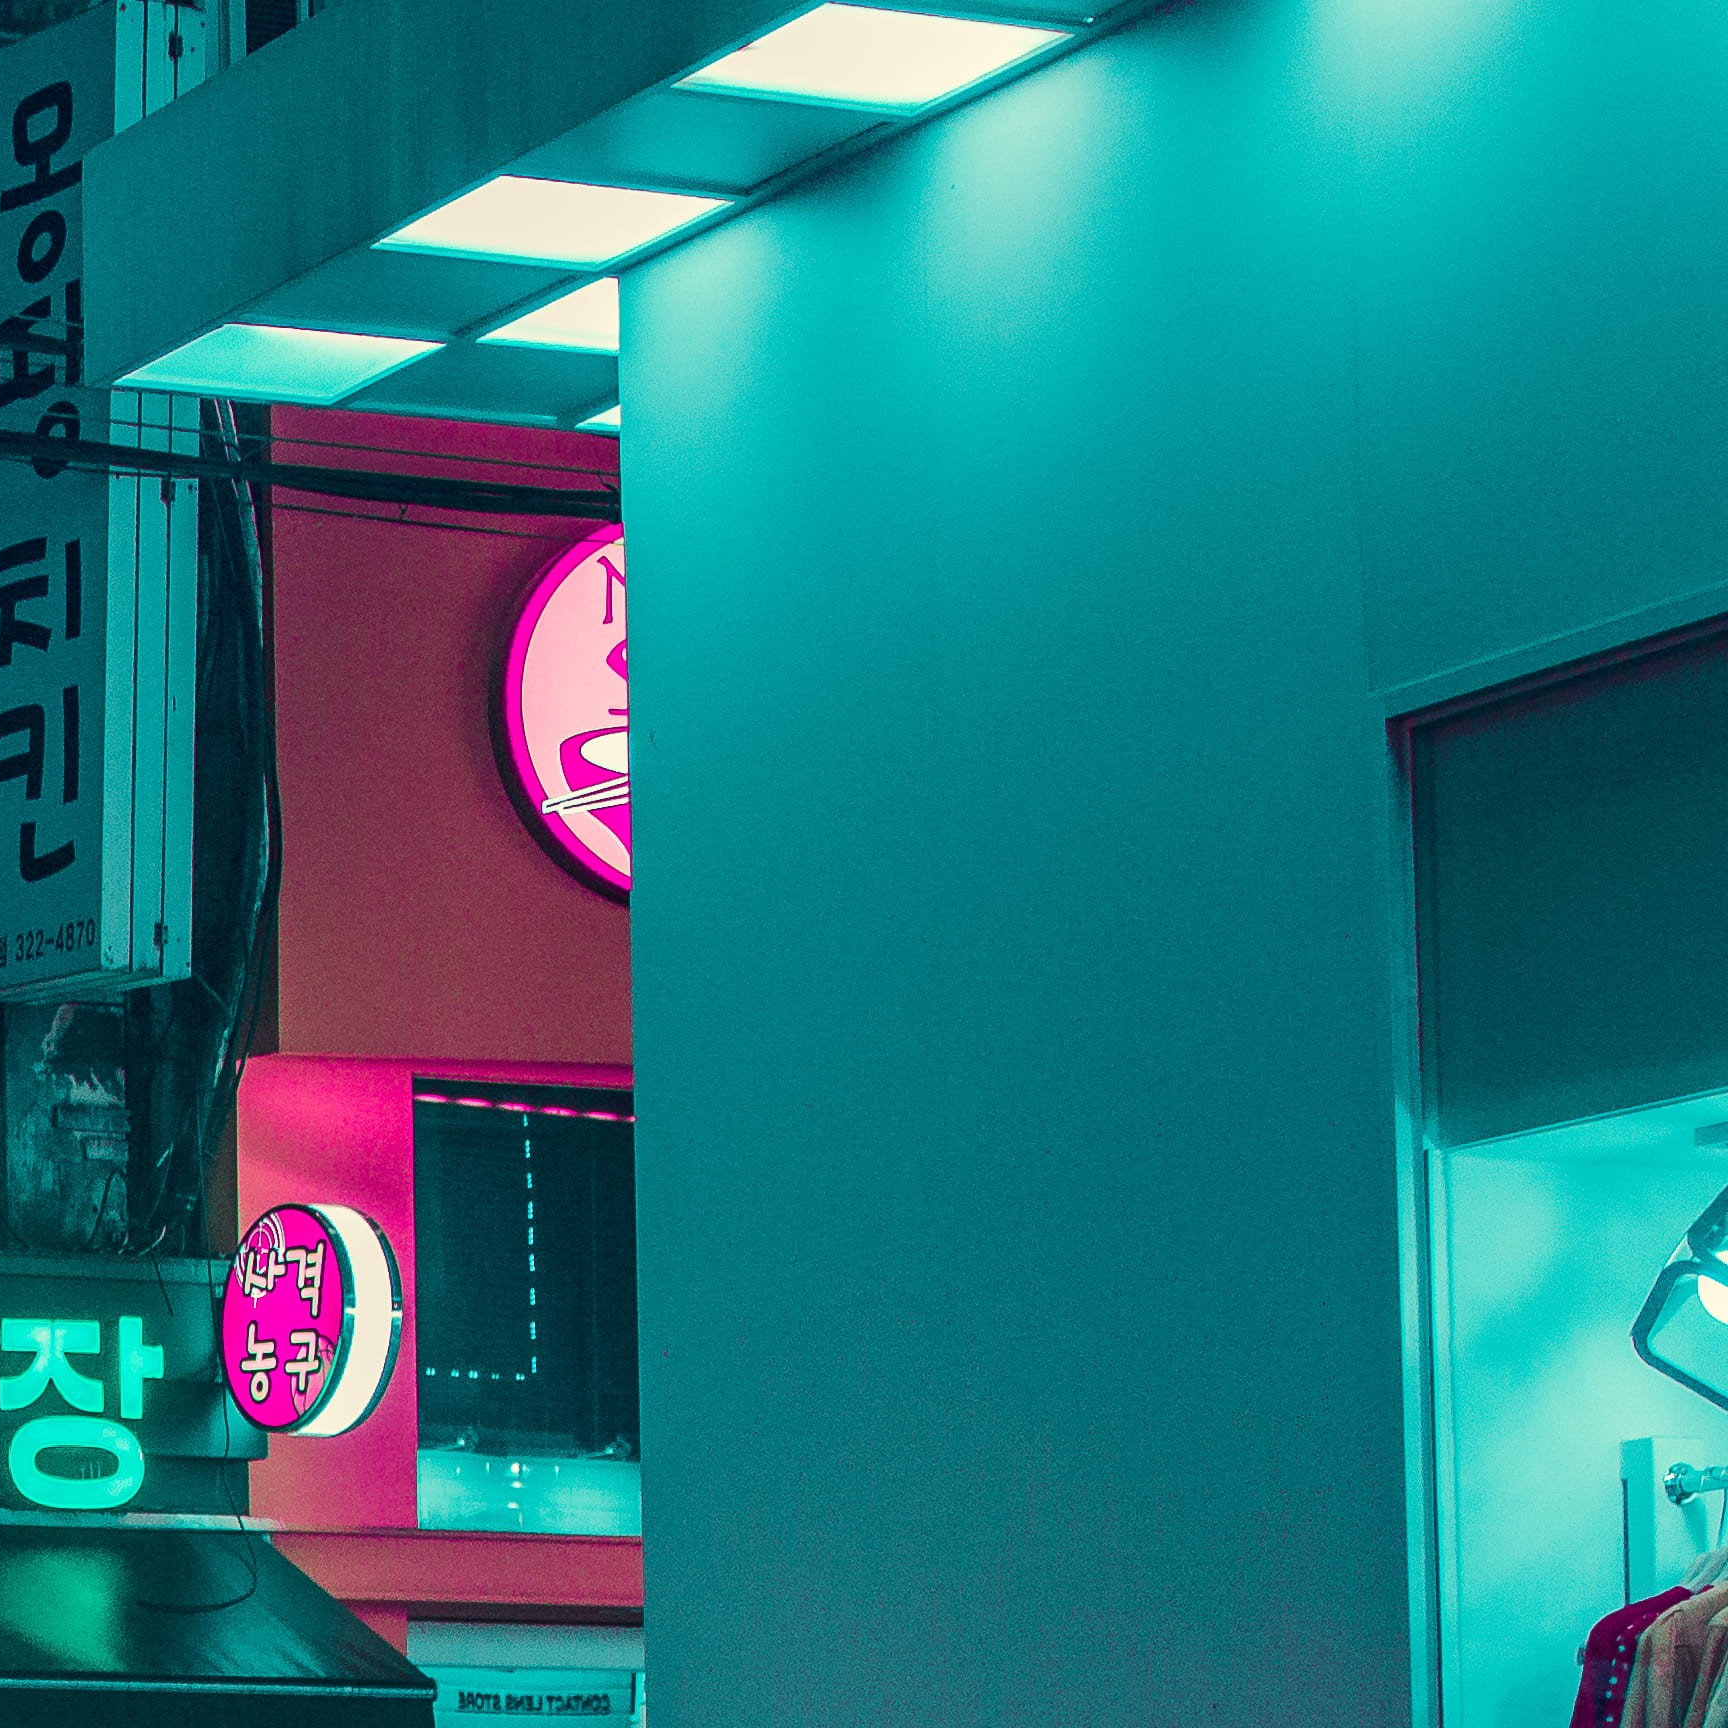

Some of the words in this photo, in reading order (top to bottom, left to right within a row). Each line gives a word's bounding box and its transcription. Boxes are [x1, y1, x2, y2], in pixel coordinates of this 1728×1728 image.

[14, 917, 96, 962] 322-4870
[243, 1240, 327, 1318] 사격
[240, 1321, 321, 1403] 농구
